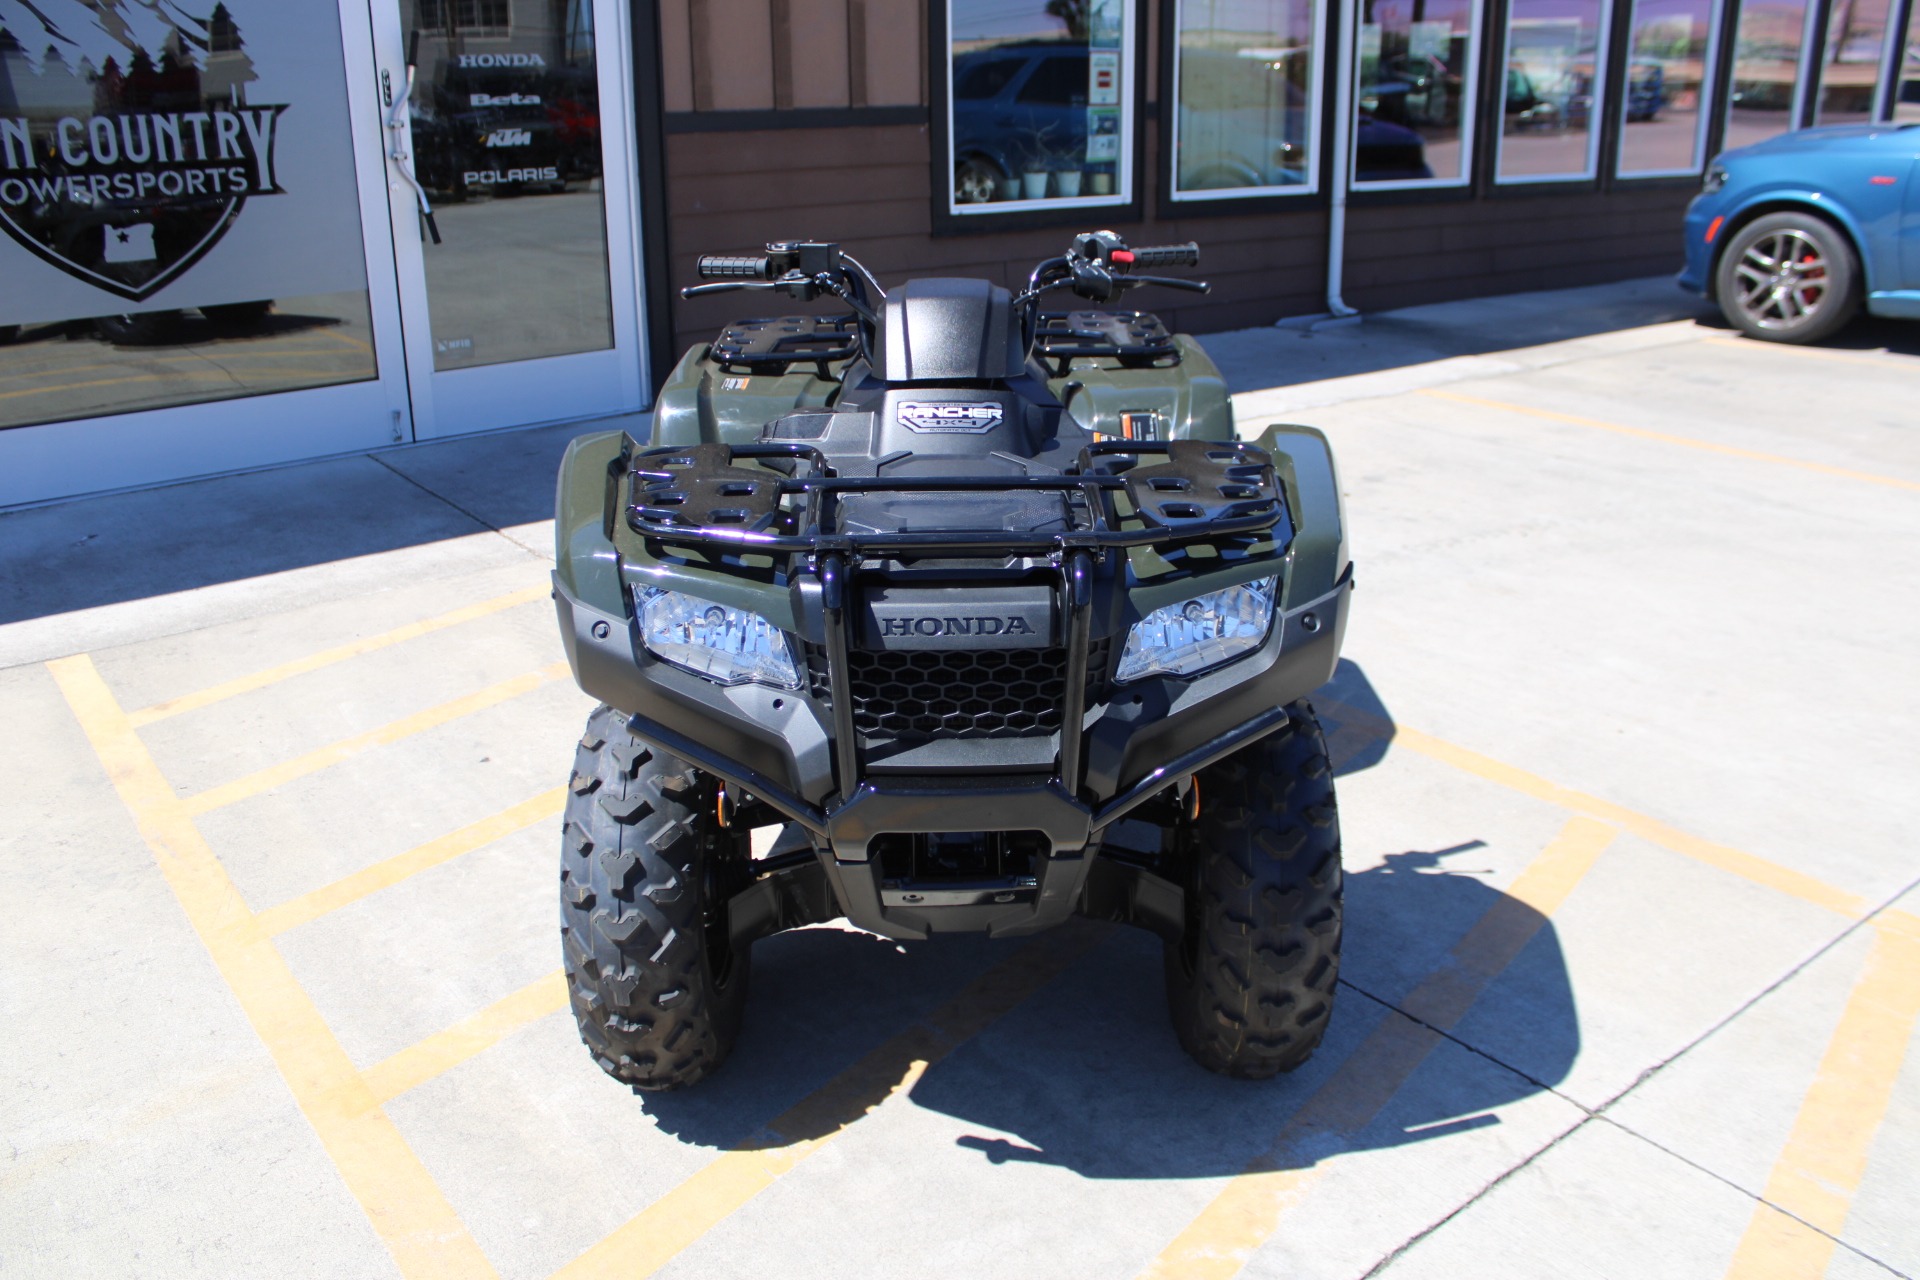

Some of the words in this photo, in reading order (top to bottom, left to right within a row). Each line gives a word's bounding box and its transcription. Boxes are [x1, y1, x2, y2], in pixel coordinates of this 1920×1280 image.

[458, 53, 546, 68] HONDA
[470, 92, 541, 107] Beta
[486, 128, 532, 147] KTM
[57, 110, 276, 190] COUNTRY
[463, 166, 559, 186] POLARIS
[897, 407, 1002, 419] RANCHER
[882, 617, 1036, 637] HONDA
